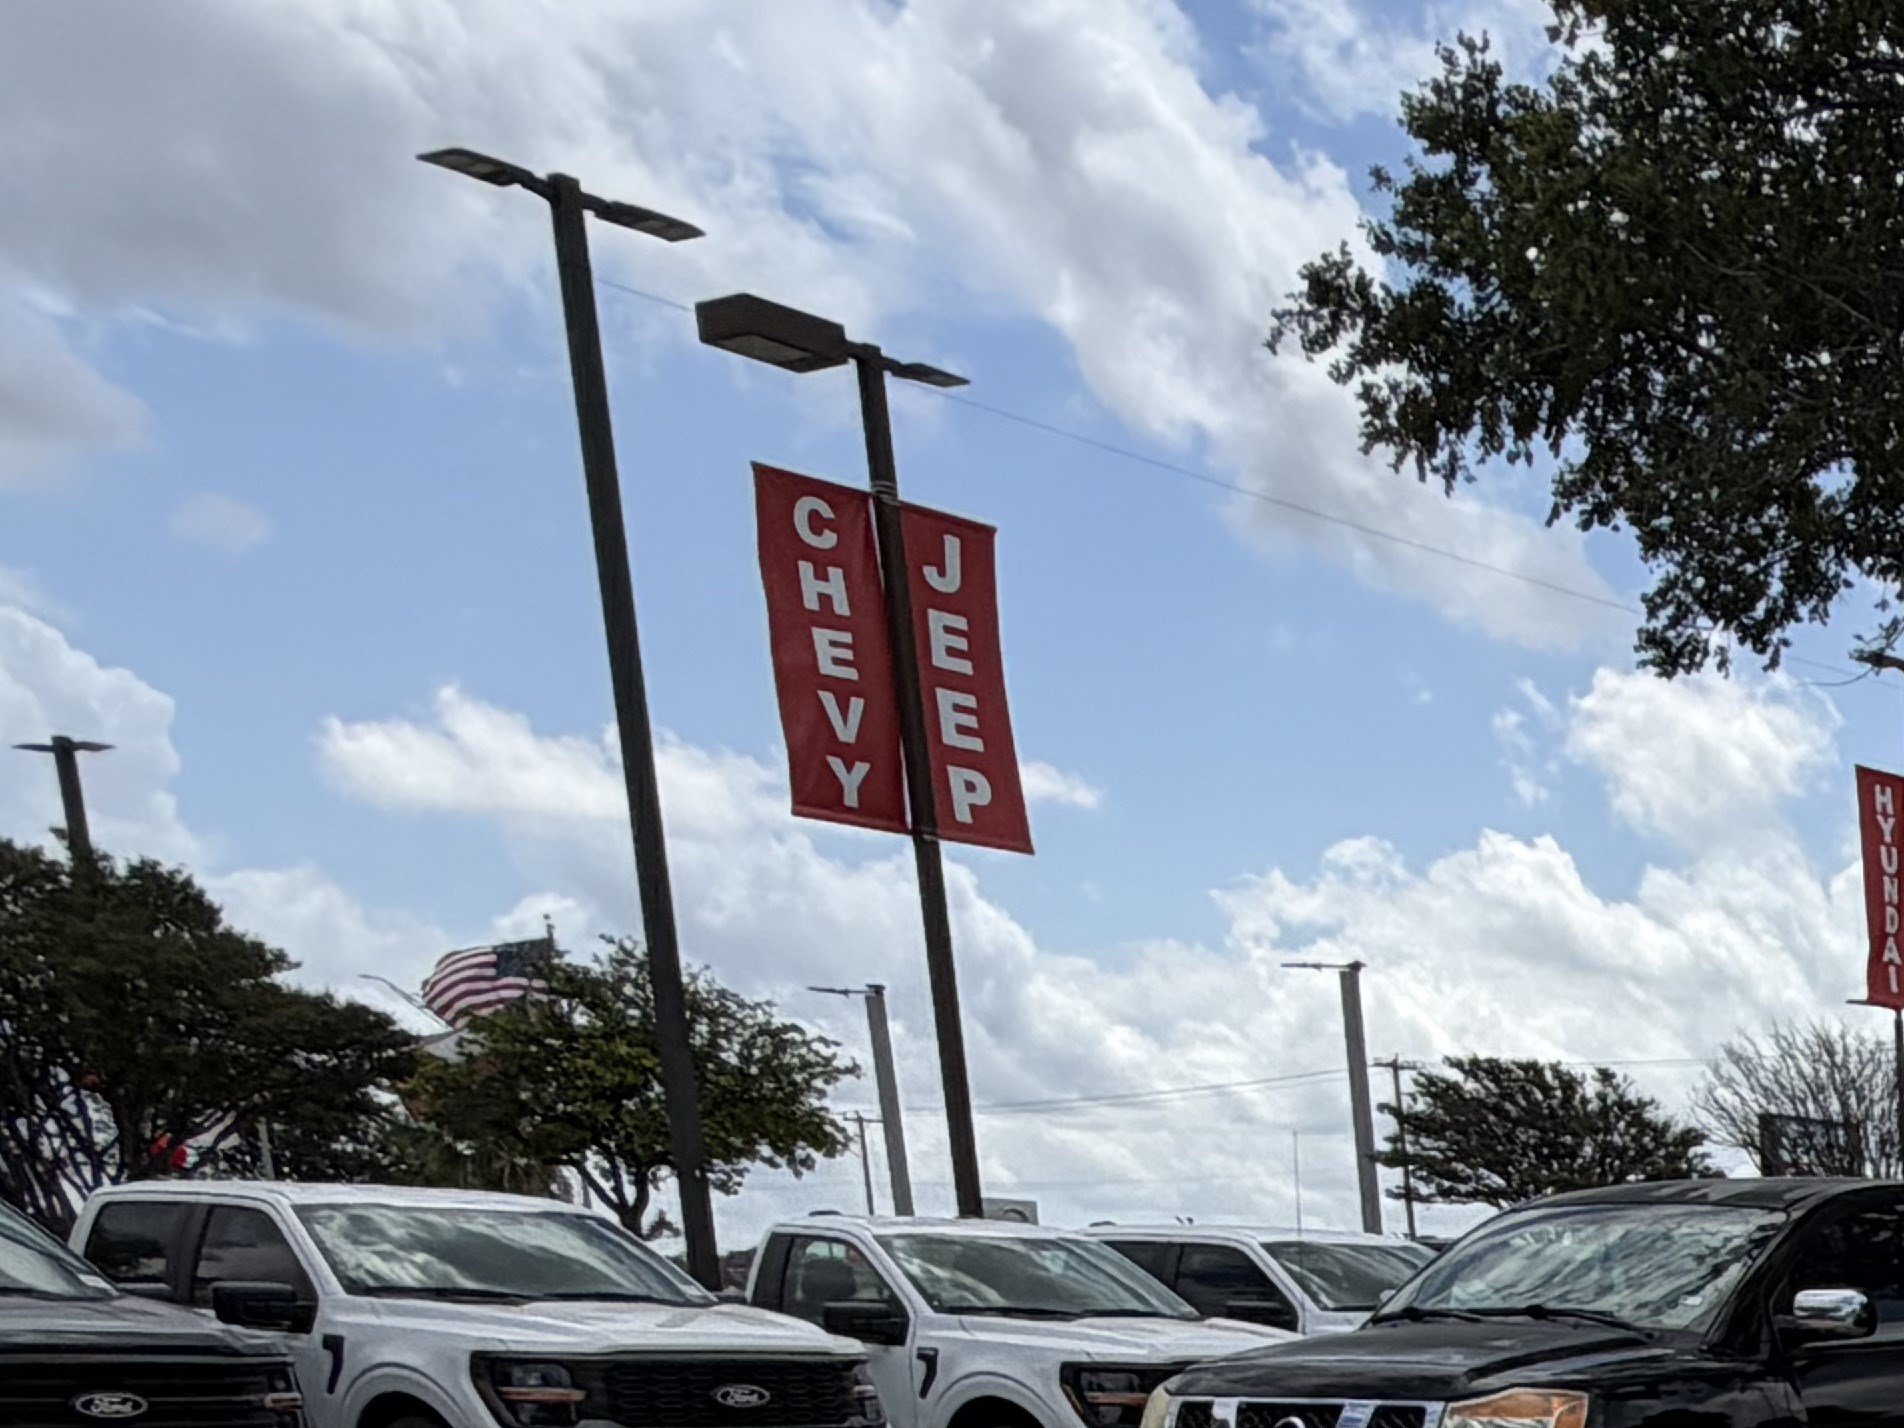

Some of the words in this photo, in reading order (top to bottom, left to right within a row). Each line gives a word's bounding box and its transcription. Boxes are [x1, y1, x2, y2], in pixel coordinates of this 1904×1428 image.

[793, 496, 871, 808] CHEVY
[923, 534, 991, 823] JEEP
[1874, 784, 1902, 994] HYUNDAI
